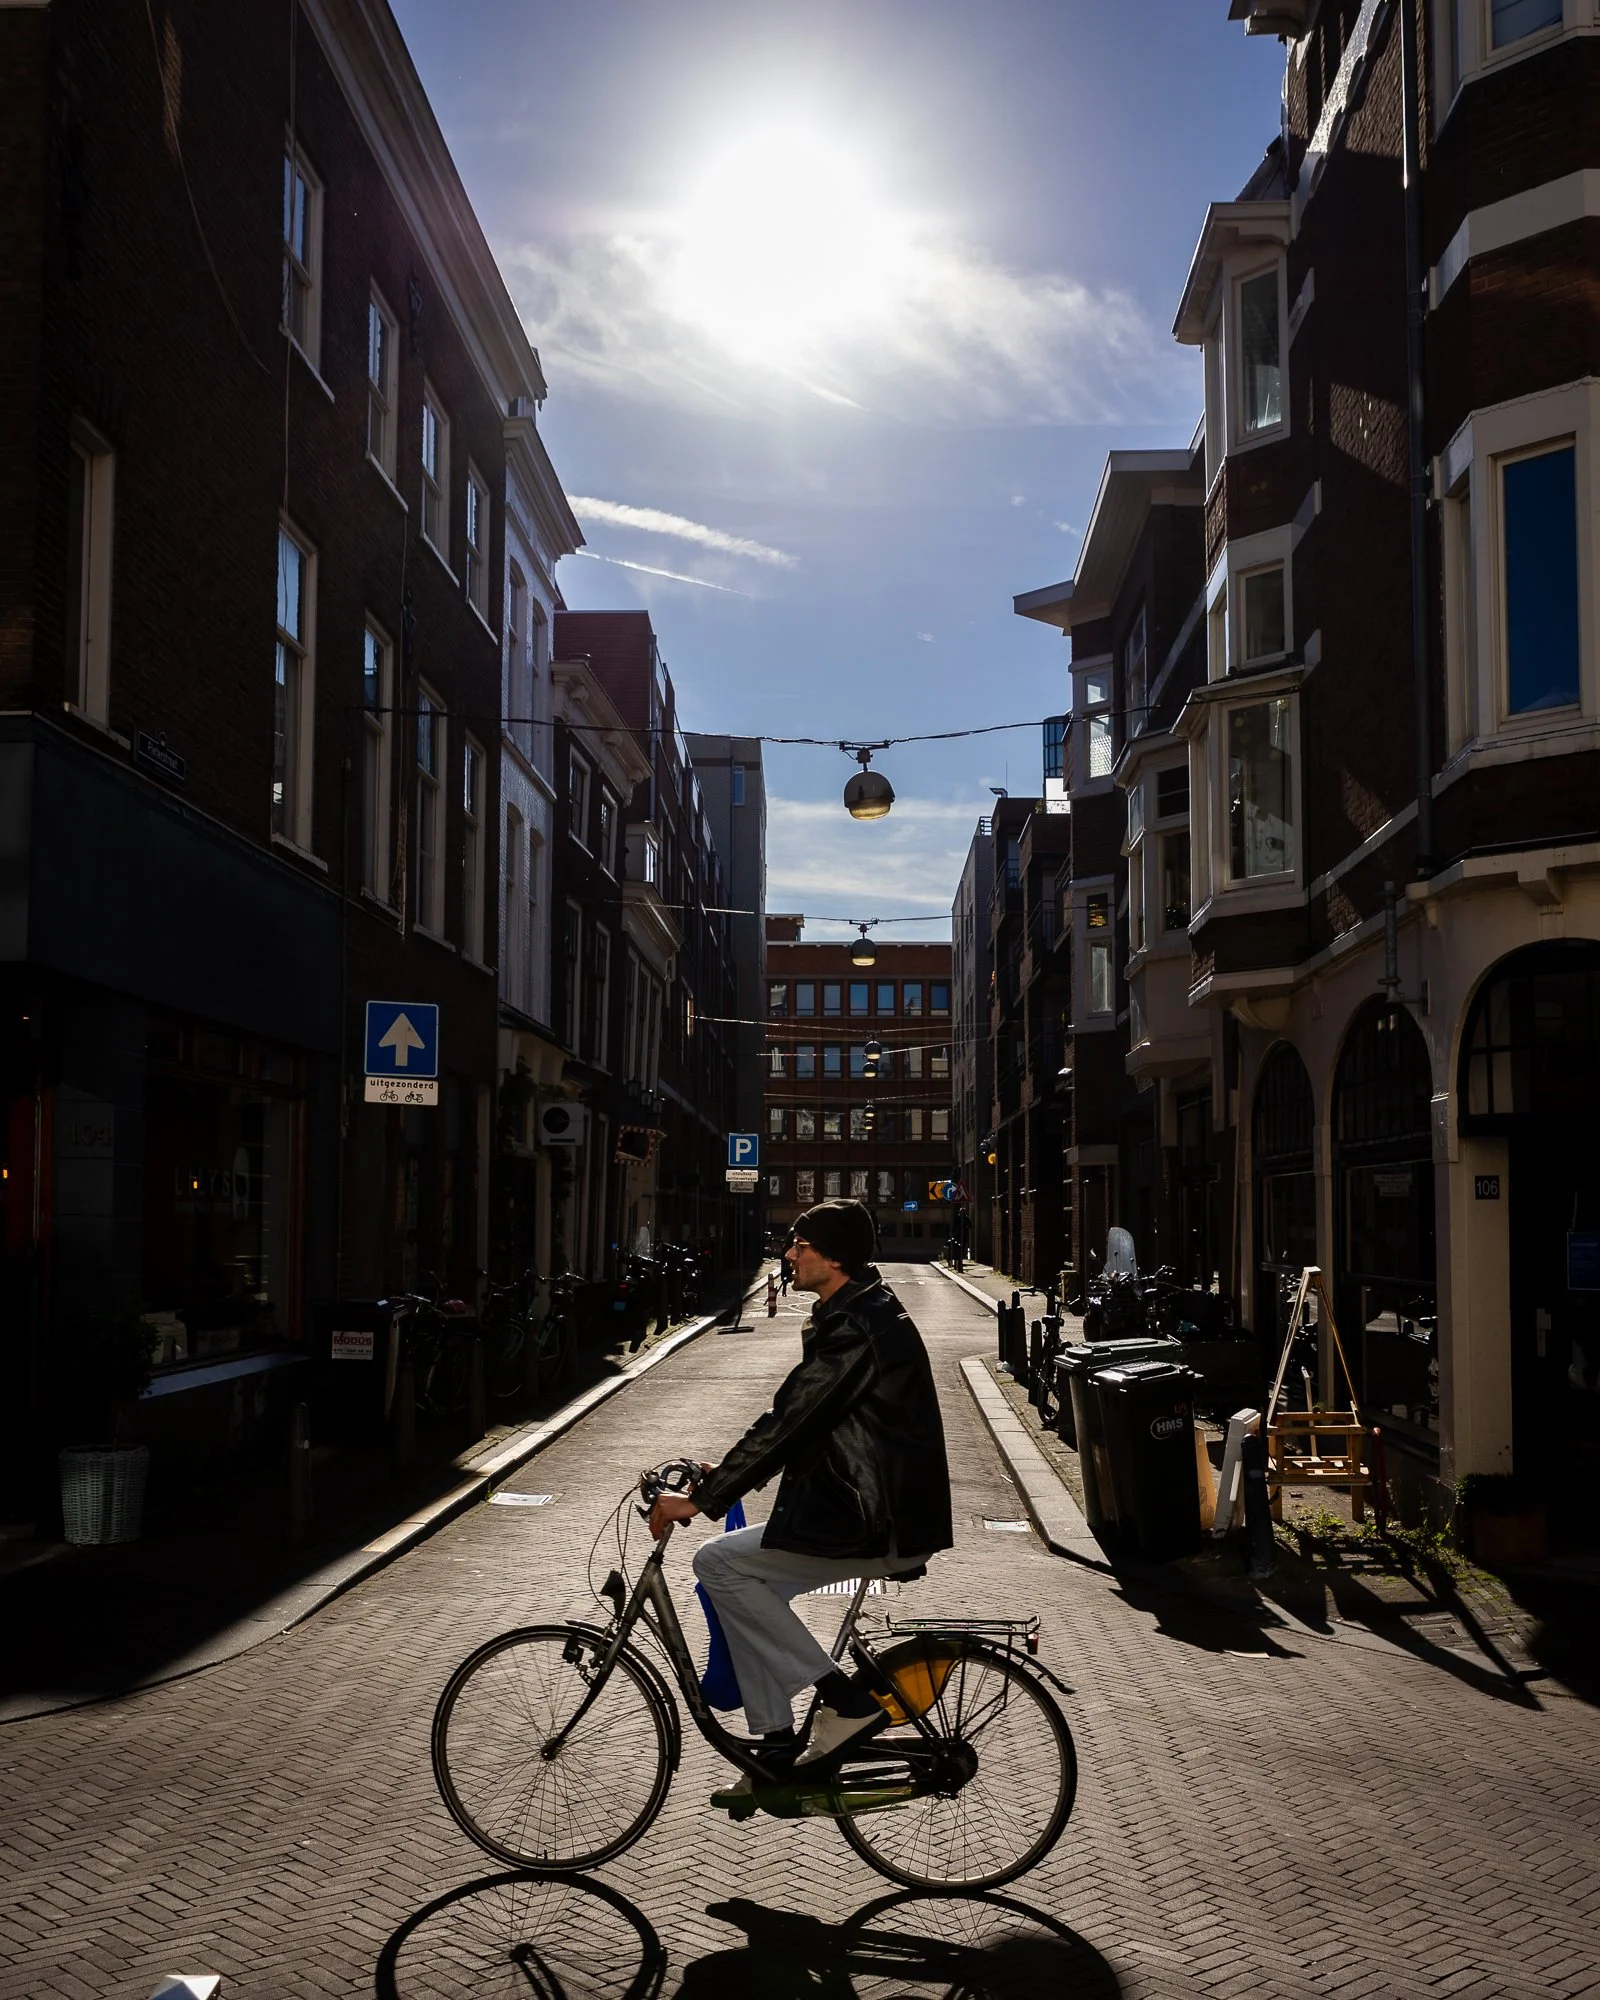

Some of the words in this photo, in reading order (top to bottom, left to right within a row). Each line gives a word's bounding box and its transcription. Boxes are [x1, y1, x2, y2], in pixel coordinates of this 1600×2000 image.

[370, 1079, 434, 1090] uitgezonderd
[66, 1122, 112, 1146] 104
[735, 1138, 752, 1162] P
[1476, 1179, 1499, 1196] 106
[333, 1335, 373, 1345] MODUS
[1156, 1417, 1184, 1433] HMS
